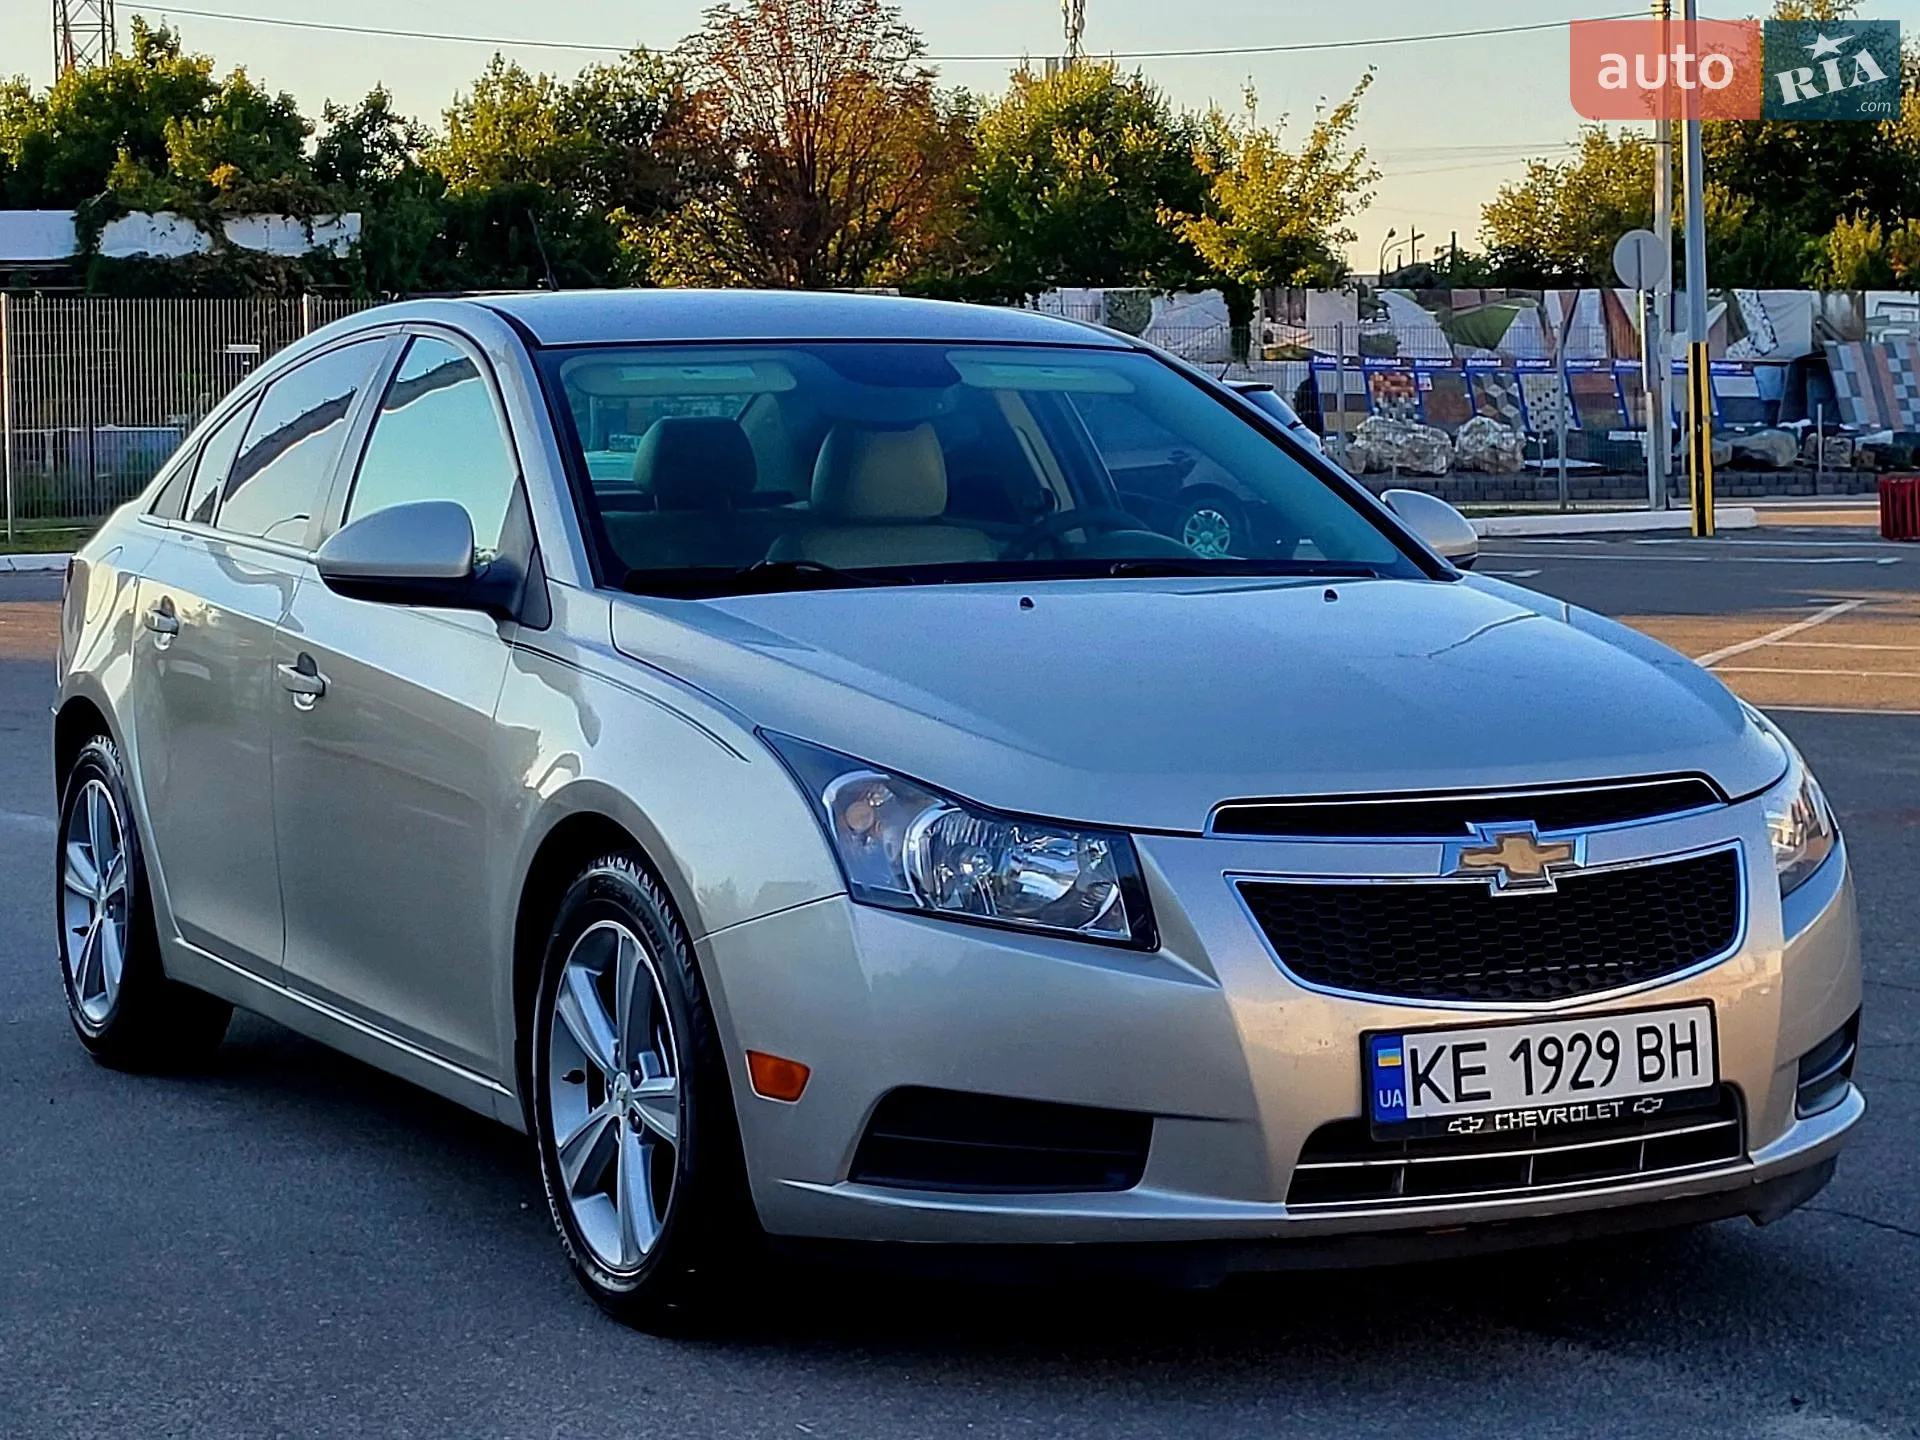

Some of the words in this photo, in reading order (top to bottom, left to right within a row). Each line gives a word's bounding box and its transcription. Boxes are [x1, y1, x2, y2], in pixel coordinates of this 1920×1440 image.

[1409, 1041, 1492, 1107] KE
[1509, 1029, 1621, 1096] 1929
[1636, 1019, 1699, 1084] BH
[1378, 1088, 1404, 1109] UA
[1494, 1100, 1624, 1132] CHEVROLET
